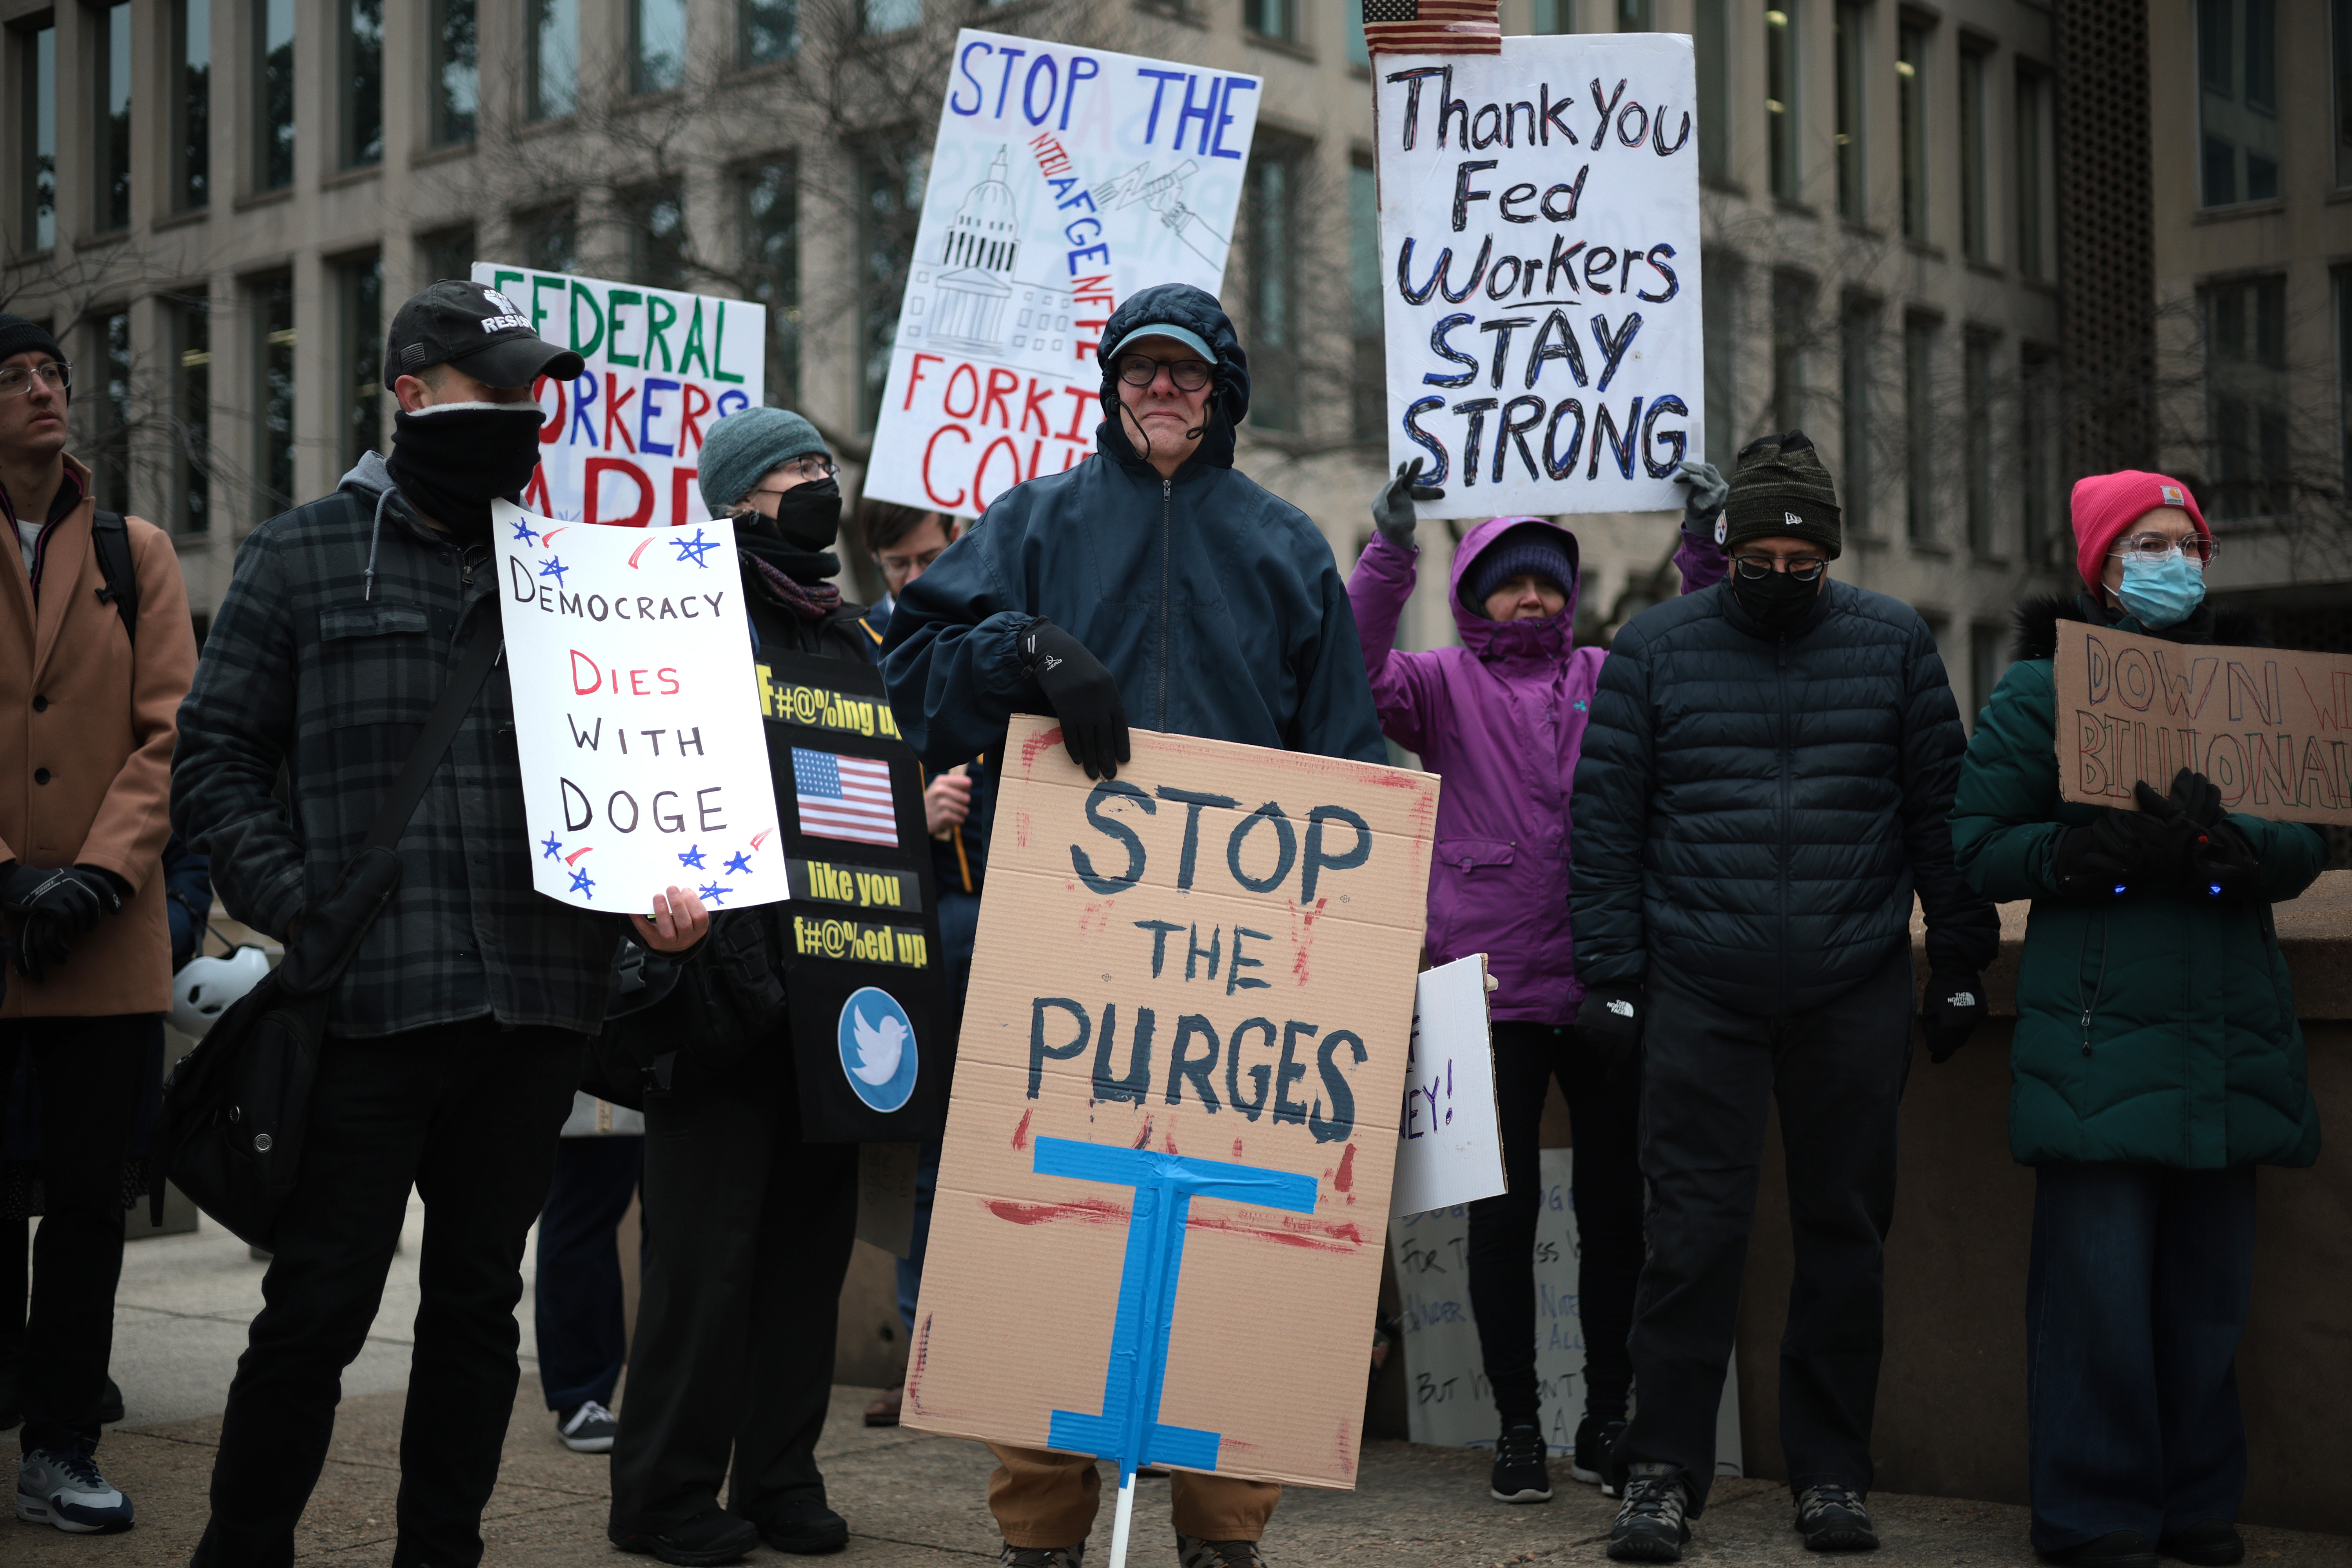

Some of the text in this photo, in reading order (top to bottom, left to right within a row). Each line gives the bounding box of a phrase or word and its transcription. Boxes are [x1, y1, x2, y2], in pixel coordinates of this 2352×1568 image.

[951, 42, 1256, 159] STOP THE
[1386, 64, 1691, 156] Thank You
[1027, 131, 1073, 178] NTEU
[1047, 178, 1111, 276] AFGE
[1452, 160, 1589, 232] Fed
[1397, 233, 1679, 306] Workers
[1421, 308, 1644, 392] STAY
[534, 370, 750, 458] ORKER
[903, 354, 1107, 445] FORKI
[1402, 394, 1688, 488] STRONG
[510, 555, 723, 622] DEMOCRACY
[569, 649, 680, 695] DIES
[755, 663, 902, 740] F#@%ing u
[1047, 659, 1062, 671] HEAD
[2086, 633, 2282, 727] DOWN
[567, 713, 704, 757] WITH
[560, 776, 728, 833] DOGE
[1070, 779, 1372, 905] STOP
[808, 860, 901, 907] like you
[793, 916, 928, 968] f#@%ed up
[1132, 919, 1273, 996] THE
[1025, 996, 1369, 1144] PURGES
[1416, 1372, 1459, 1405] BUT
